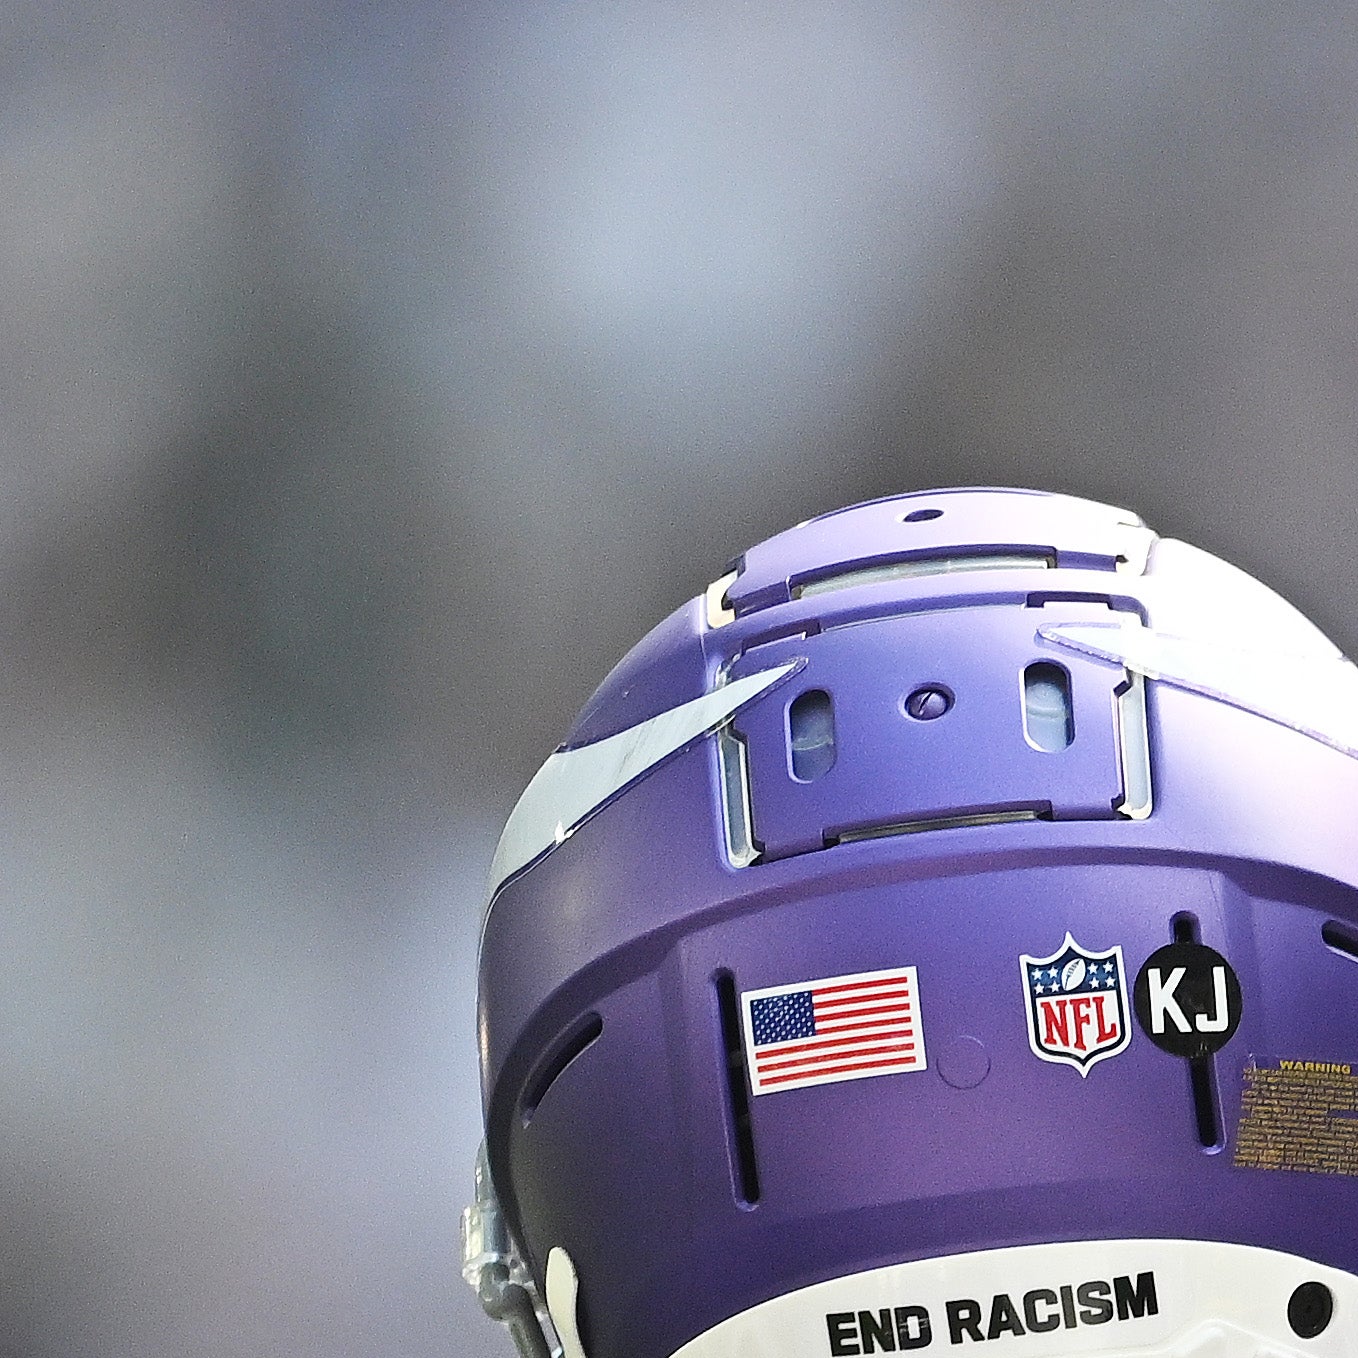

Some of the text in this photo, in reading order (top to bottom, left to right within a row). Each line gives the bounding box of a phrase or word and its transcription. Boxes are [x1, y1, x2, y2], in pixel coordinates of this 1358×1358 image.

[1040, 996, 1118, 1051] NFL
[1148, 966, 1229, 1034] KJ
[1279, 1060, 1352, 1075] WARNING
[826, 1270, 1160, 1357] END RACISM
